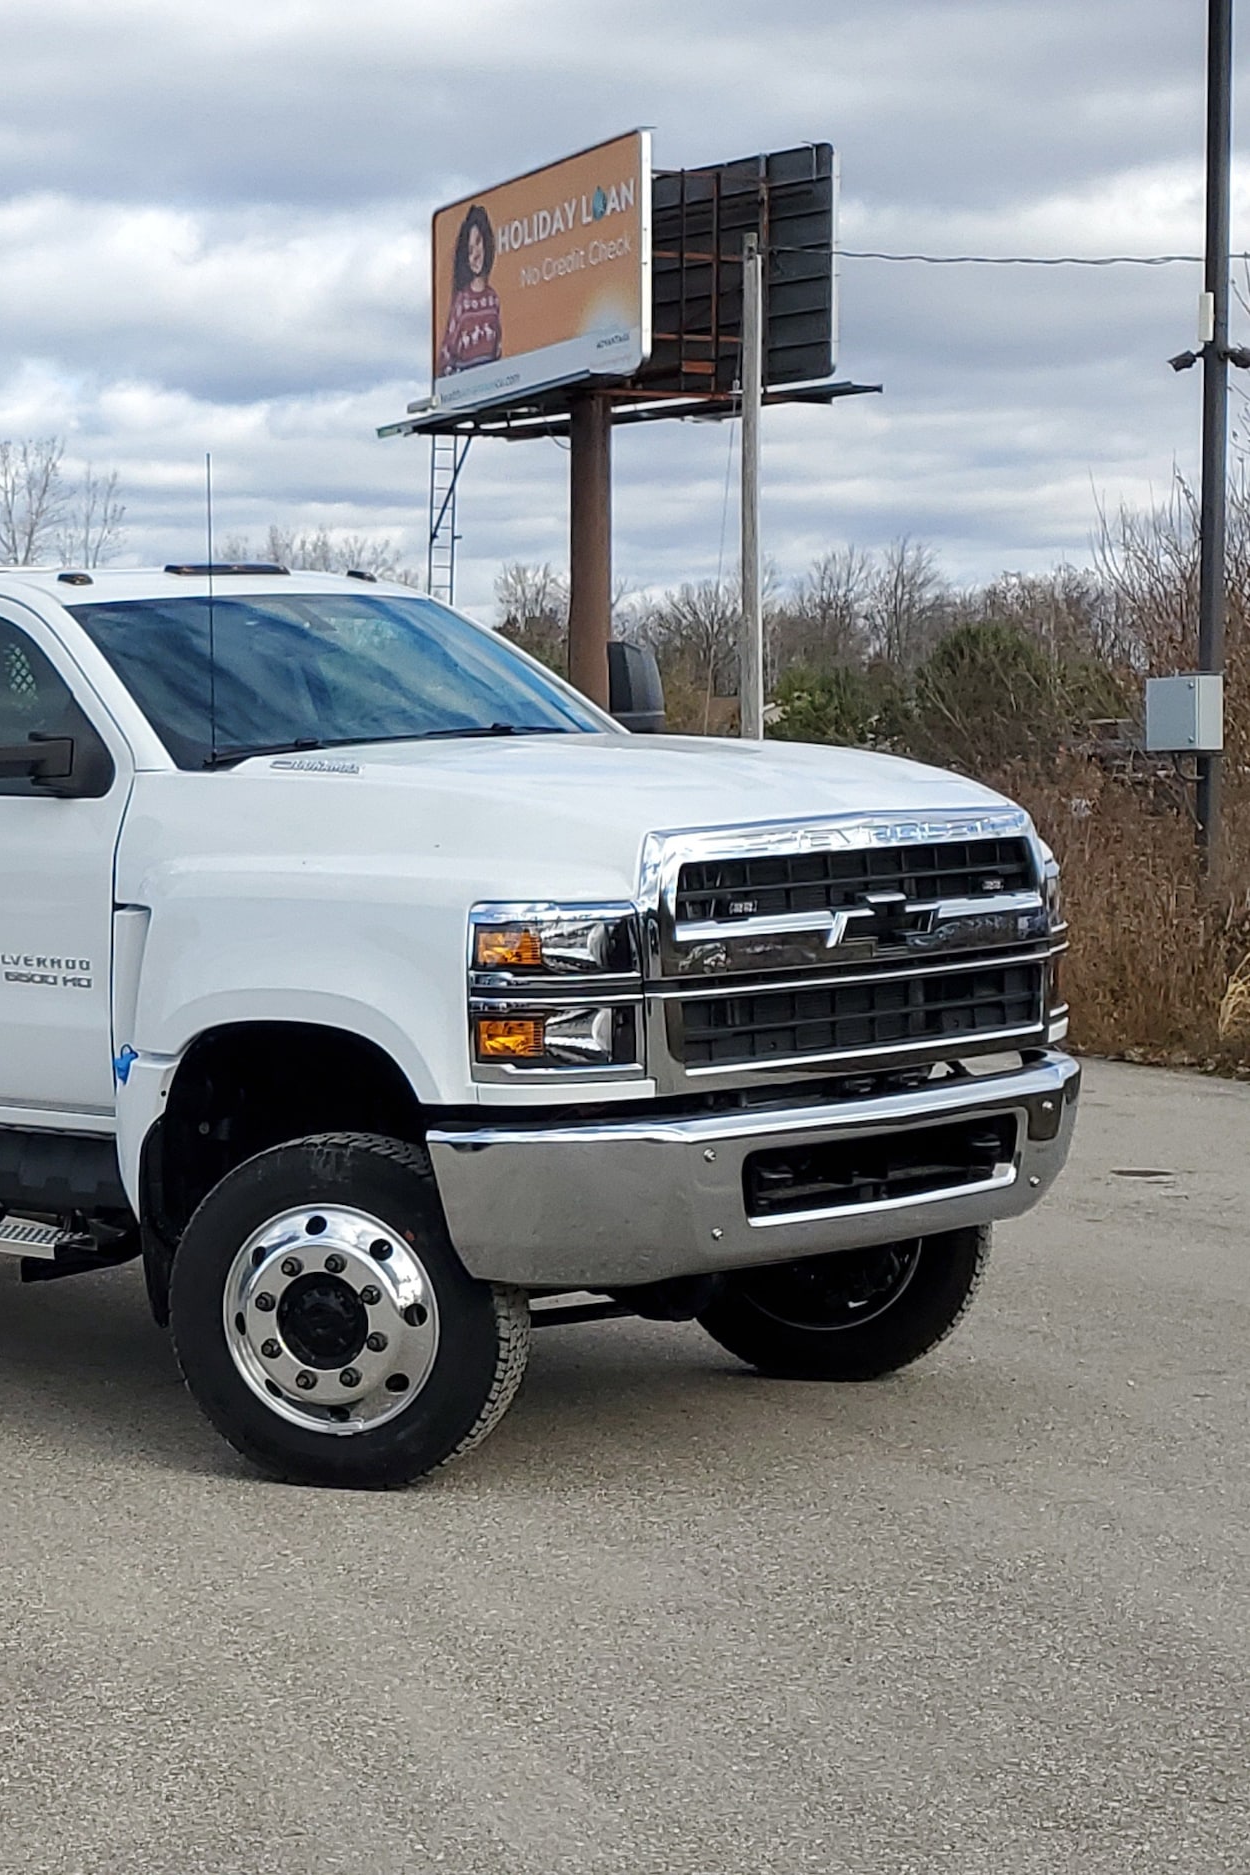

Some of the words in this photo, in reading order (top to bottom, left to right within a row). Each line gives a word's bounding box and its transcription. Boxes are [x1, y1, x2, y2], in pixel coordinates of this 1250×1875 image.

[497, 198, 578, 254] HOLIDAY
[581, 178, 635, 225] LOAN
[519, 264, 541, 288] No
[542, 249, 586, 281] Credit
[589, 231, 631, 265] Check
[61, 976, 92, 989] HD
